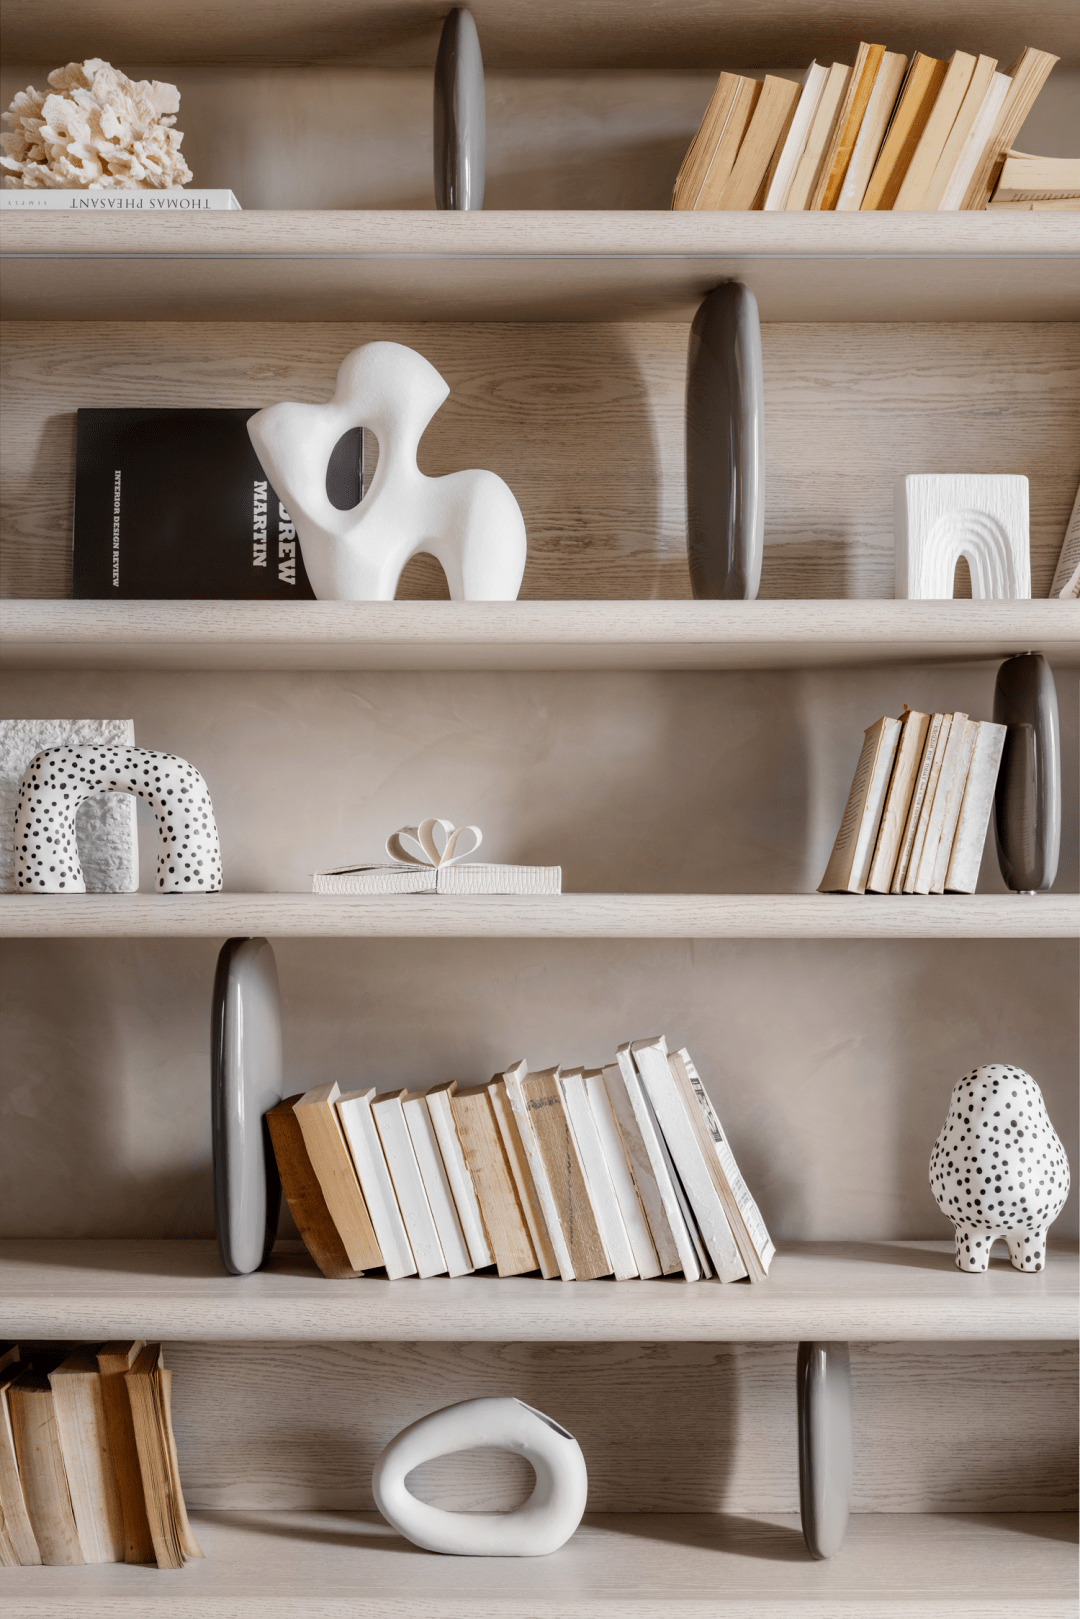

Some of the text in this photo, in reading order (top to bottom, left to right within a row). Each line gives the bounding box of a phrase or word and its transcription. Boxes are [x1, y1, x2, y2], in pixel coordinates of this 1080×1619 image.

[69, 198, 144, 209] PHEASANT
[149, 198, 211, 209] THOMAS
[112, 470, 121, 587] INTERIOR DESIGN REVIEW
[252, 480, 268, 567] MARTIN
[277, 501, 296, 585] DREW
